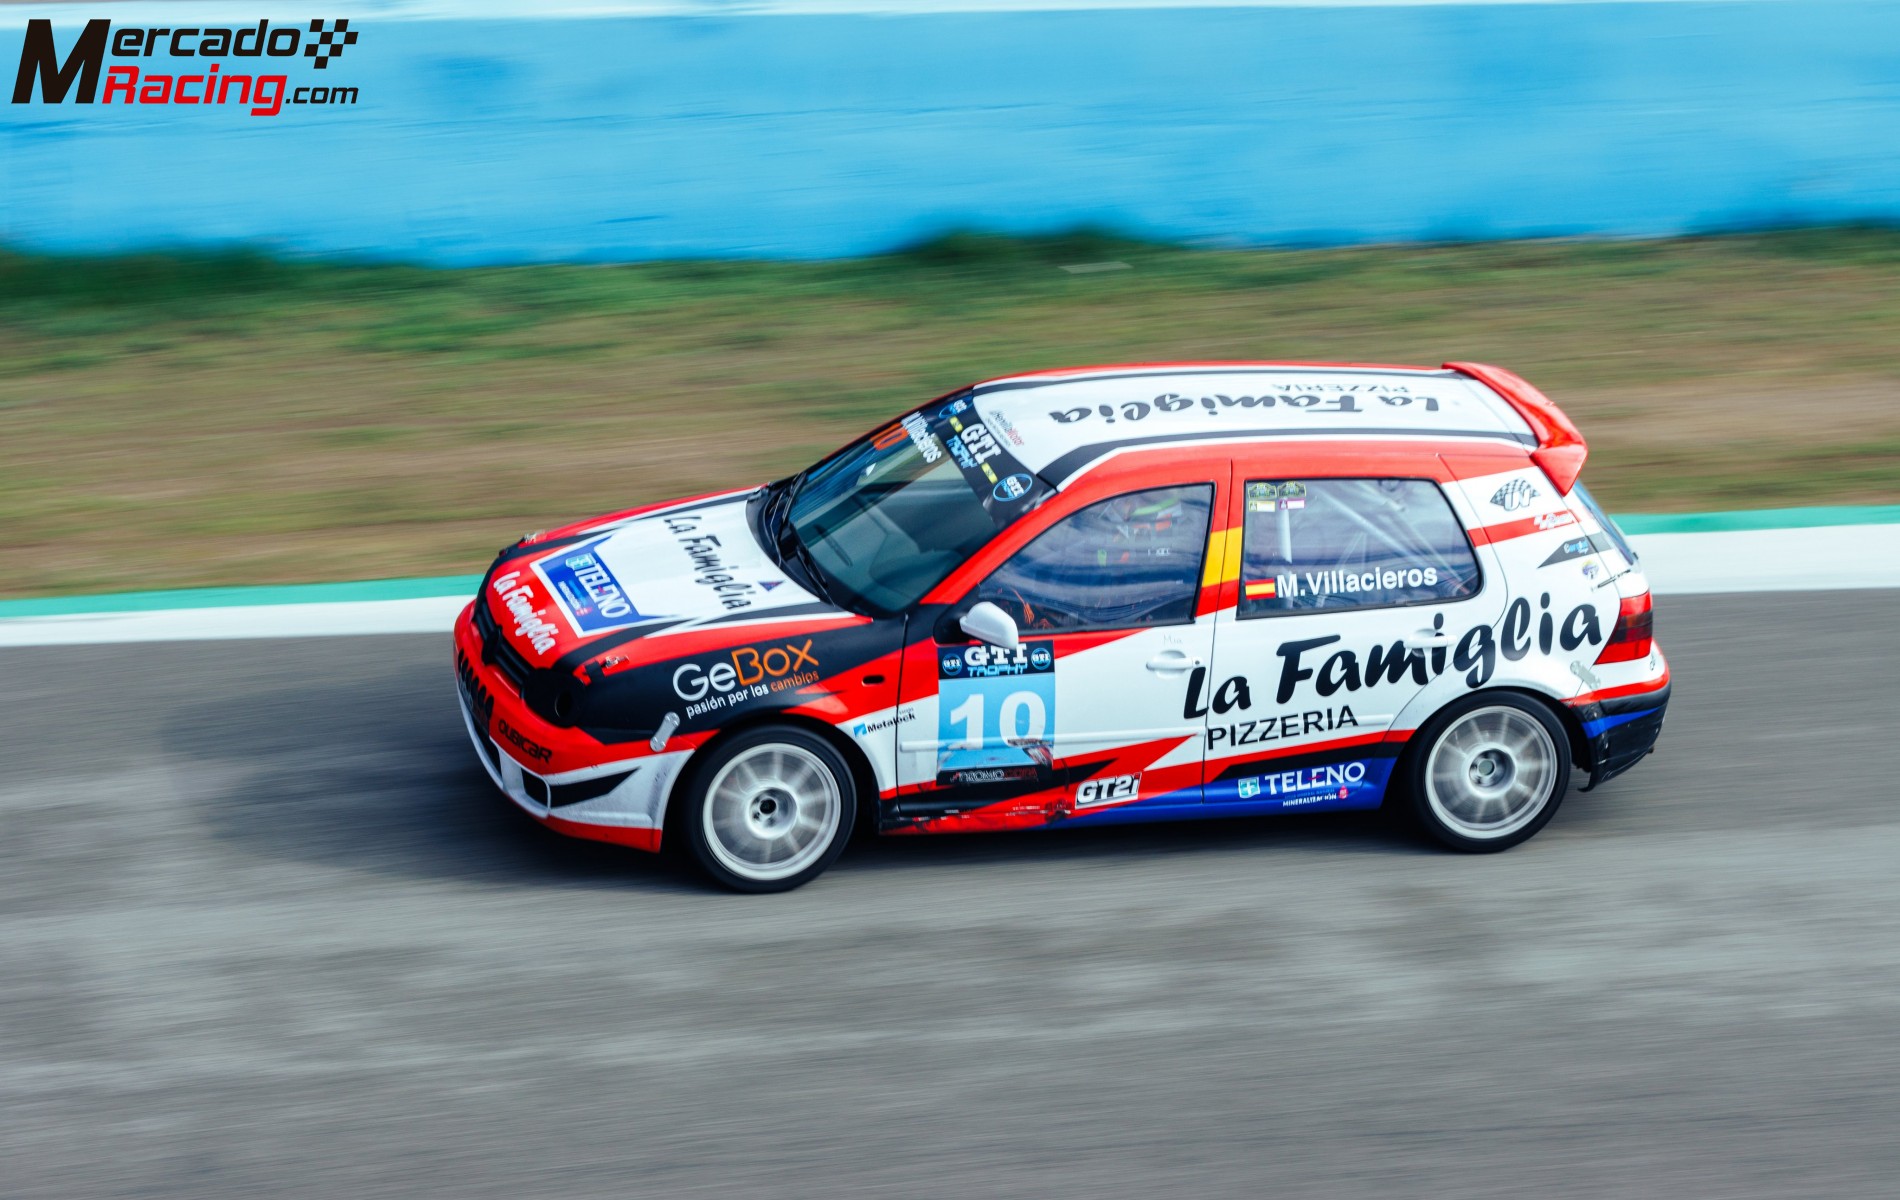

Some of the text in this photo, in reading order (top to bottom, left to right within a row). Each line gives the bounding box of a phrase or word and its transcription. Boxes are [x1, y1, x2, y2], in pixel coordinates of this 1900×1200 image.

[1048, 393, 1440, 424] La Famiglia
[961, 423, 1002, 464] GTI
[664, 515, 756, 611] La Famiglia
[1276, 566, 1438, 599] M.Villacieros
[574, 562, 633, 619] TELENO
[502, 585, 560, 656] Famiglia
[964, 643, 1028, 667] GTI
[1183, 591, 1601, 720] La Famiglia
[685, 669, 820, 720] pasión por los cambios
[950, 690, 1047, 751] 10
[1207, 705, 1359, 751] PIZZERIA
[1076, 775, 1140, 804] GT2i
[1264, 762, 1366, 796] TELENO
